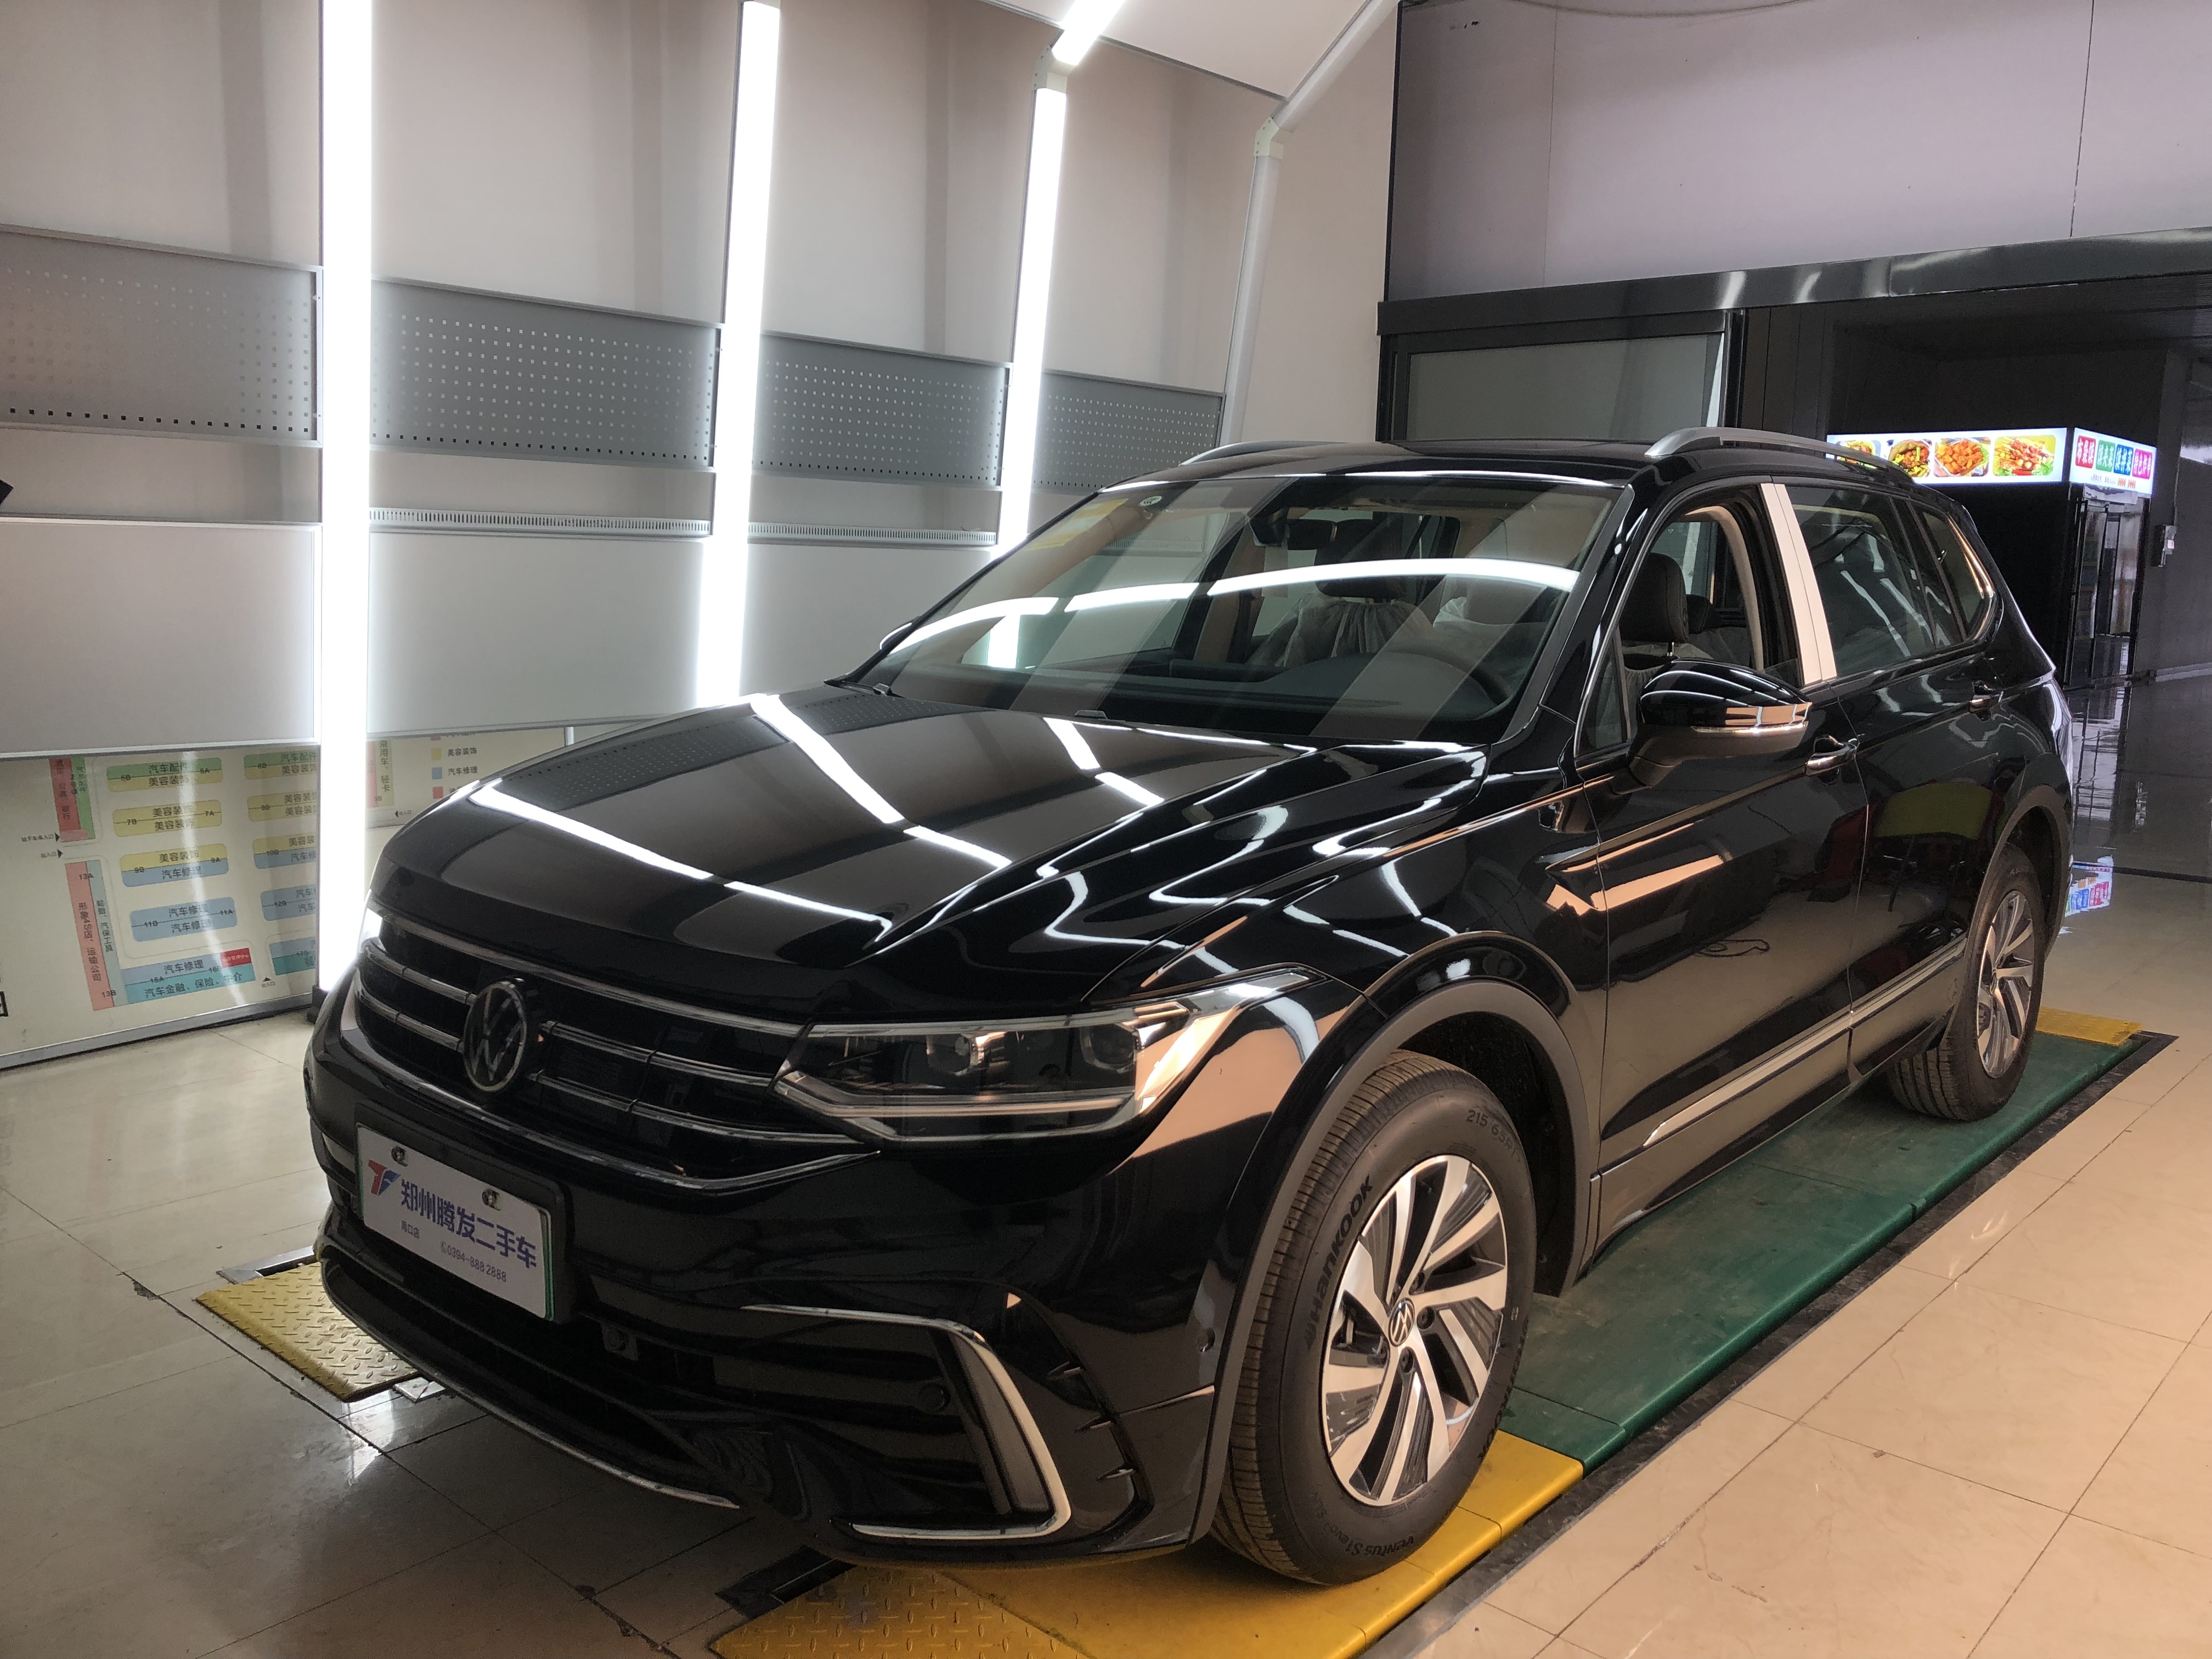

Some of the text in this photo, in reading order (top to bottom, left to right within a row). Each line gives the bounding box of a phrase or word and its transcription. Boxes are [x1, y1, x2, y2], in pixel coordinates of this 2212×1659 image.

[448, 747, 477, 757] 美容装饰
[448, 766, 478, 776] 汽车修理
[163, 959, 205, 974] 汽车修理
[400, 1178, 538, 1269] 郑州腾发二手车
